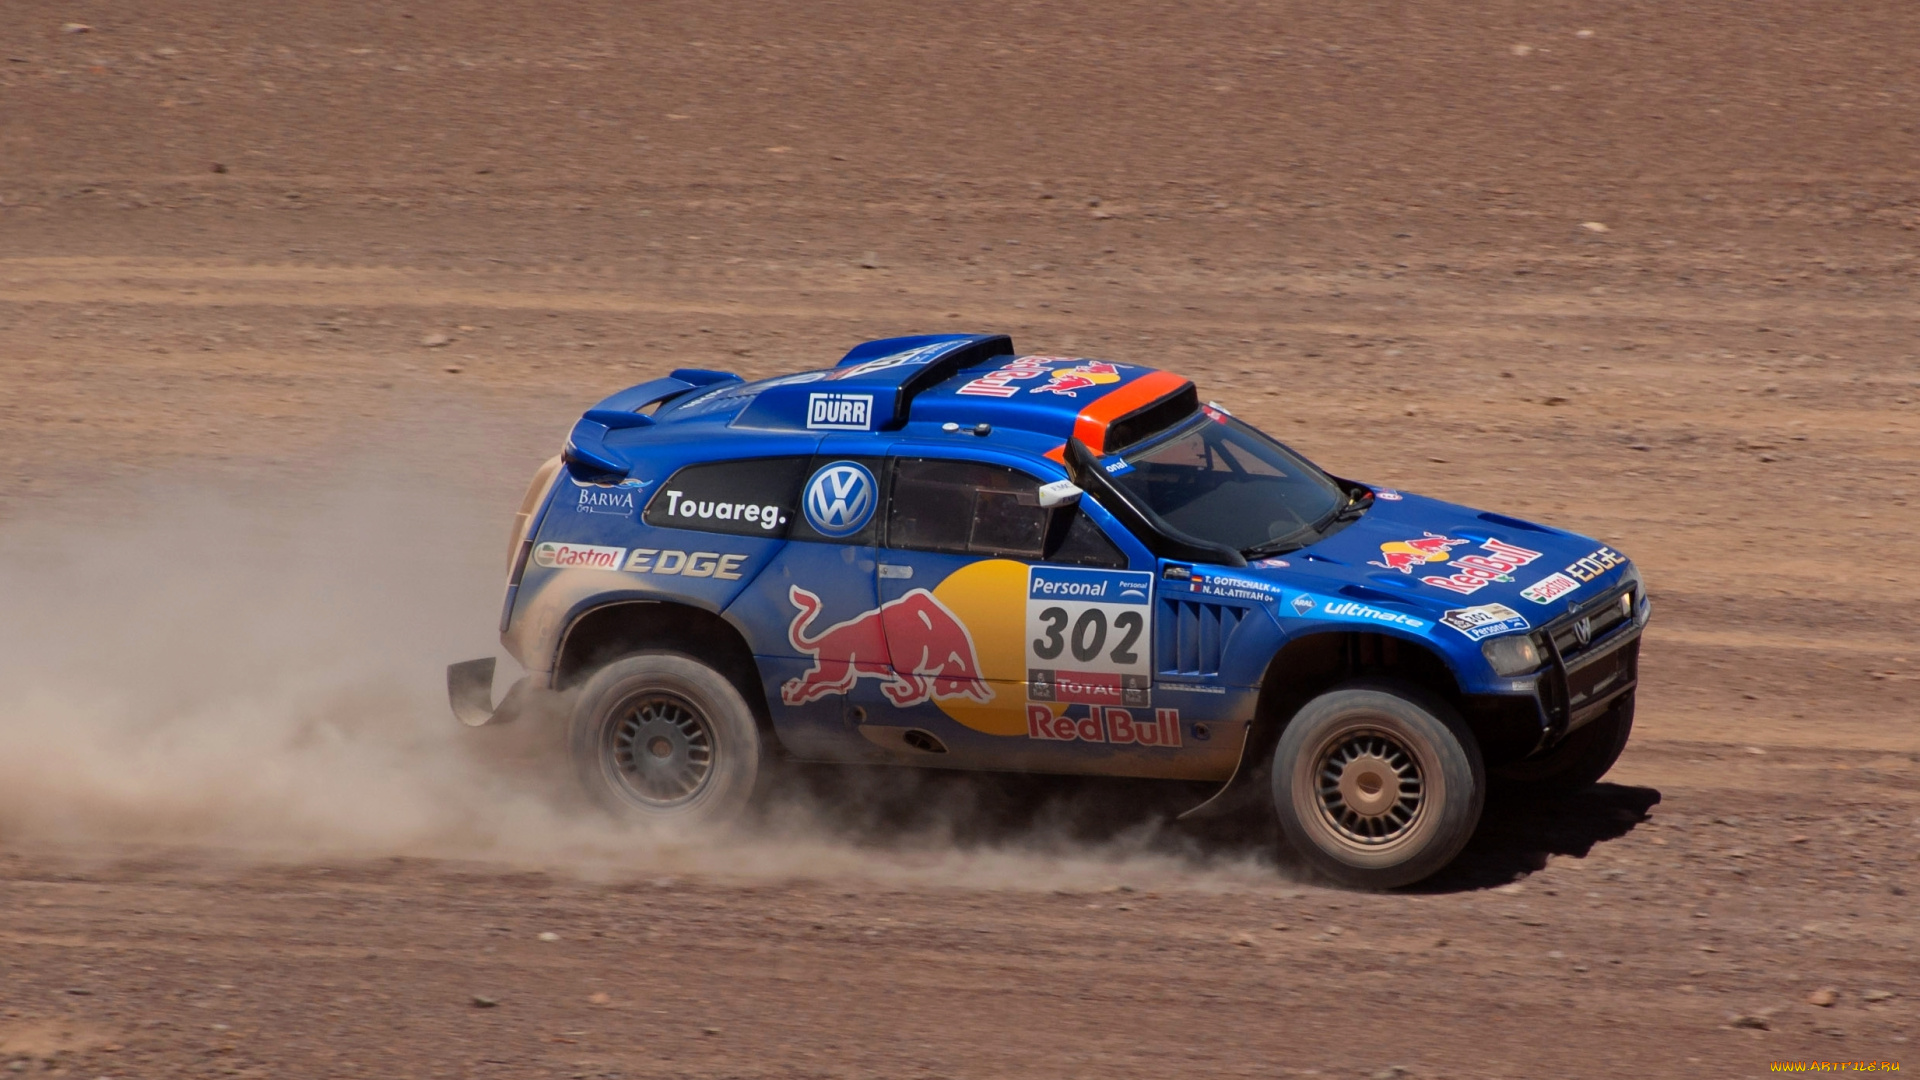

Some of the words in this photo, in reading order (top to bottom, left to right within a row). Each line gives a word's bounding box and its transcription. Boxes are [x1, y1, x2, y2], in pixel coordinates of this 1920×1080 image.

[813, 393, 866, 423] DÜRR
[578, 488, 634, 508] BARWA
[666, 490, 786, 530] Touareg.
[554, 545, 620, 568] Castrol
[622, 548, 749, 581] EDGE
[1532, 574, 1577, 599] Castrol
[1565, 546, 1627, 583] EDGE
[1032, 577, 1108, 597] Personal
[1119, 580, 1148, 589] Personal
[1202, 585, 1212, 595] N.
[1213, 576, 1271, 592] GOTTSCHALK
[1324, 602, 1424, 628] ultimate
[1464, 612, 1493, 624] 302
[1032, 606, 1144, 665] 302
[1471, 621, 1509, 637] Personal
[1056, 678, 1120, 697] TOTAL
[1025, 702, 1106, 744] Red
[1104, 707, 1183, 748] Bull
